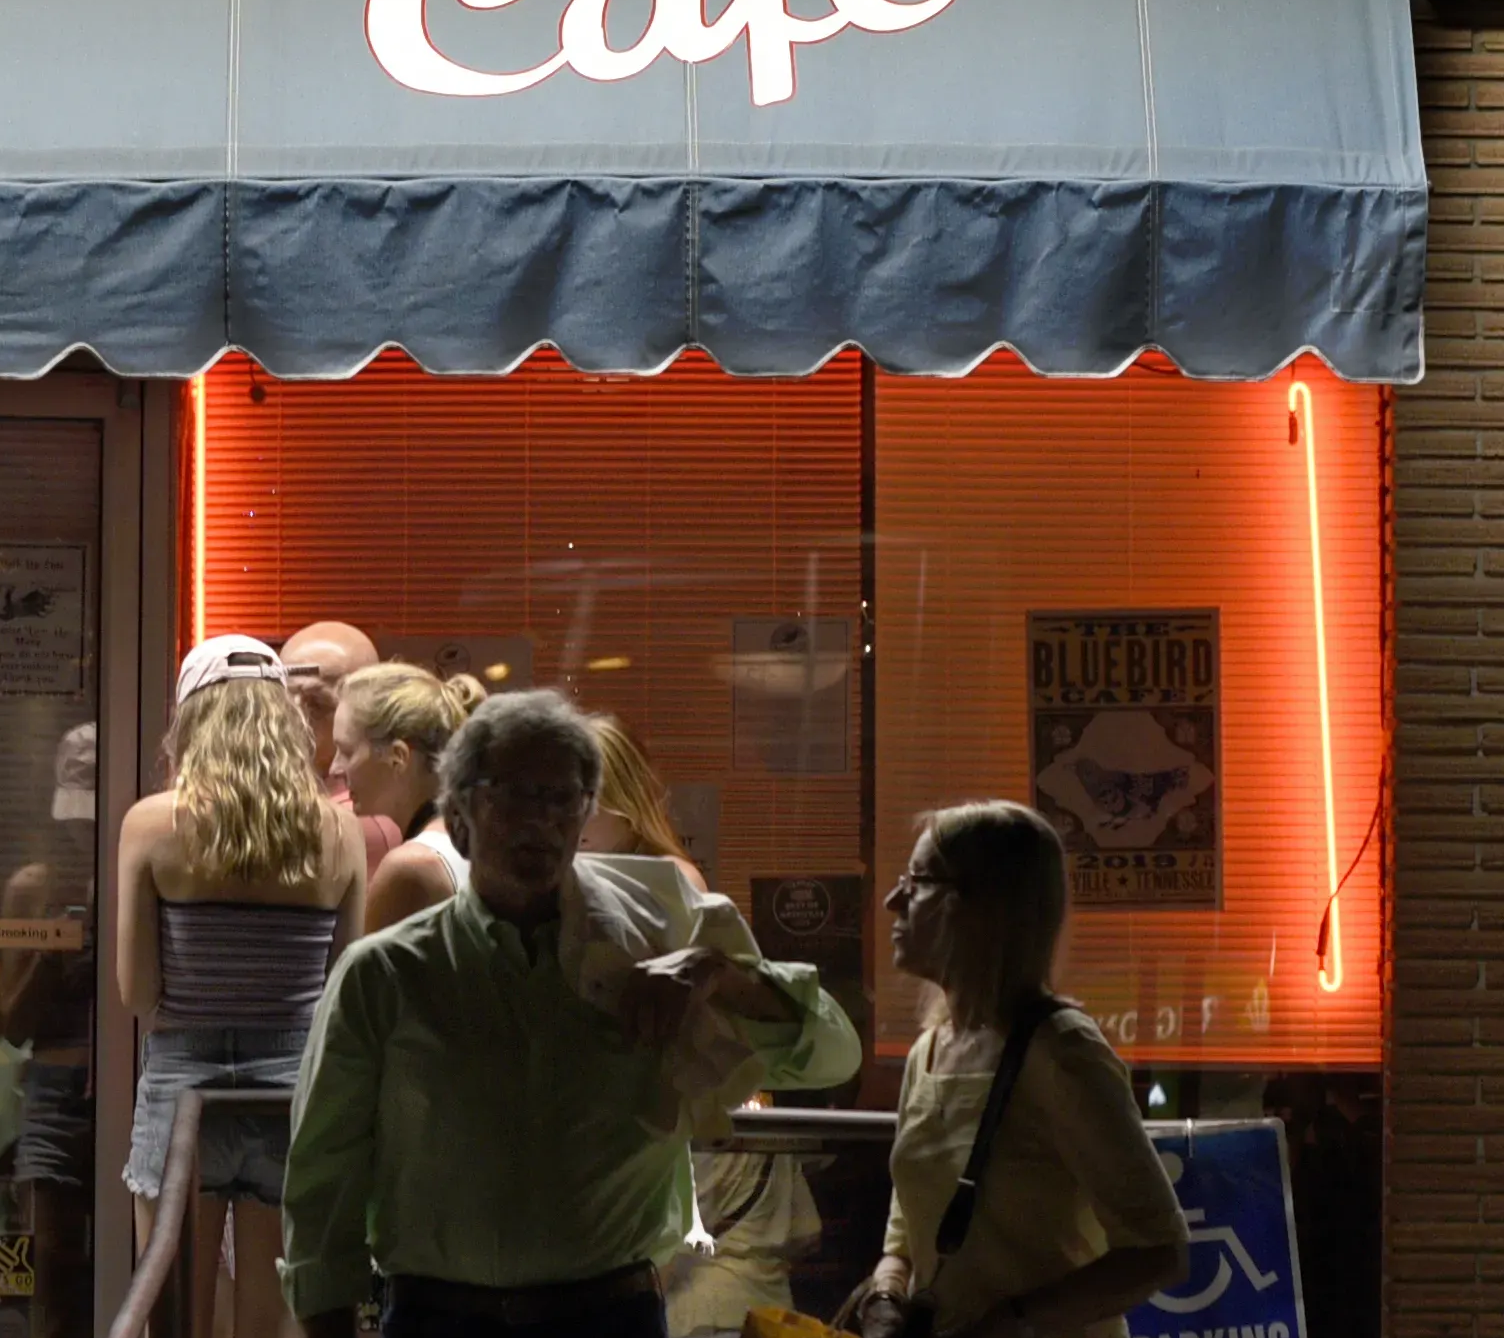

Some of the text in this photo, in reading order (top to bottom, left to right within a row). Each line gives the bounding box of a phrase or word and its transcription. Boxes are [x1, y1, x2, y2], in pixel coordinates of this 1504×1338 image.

[1075, 622, 1170, 637] THE
[1033, 639, 1213, 689] BLUEBIRD
[1072, 871, 1215, 891] VILLE TENNESSEE
